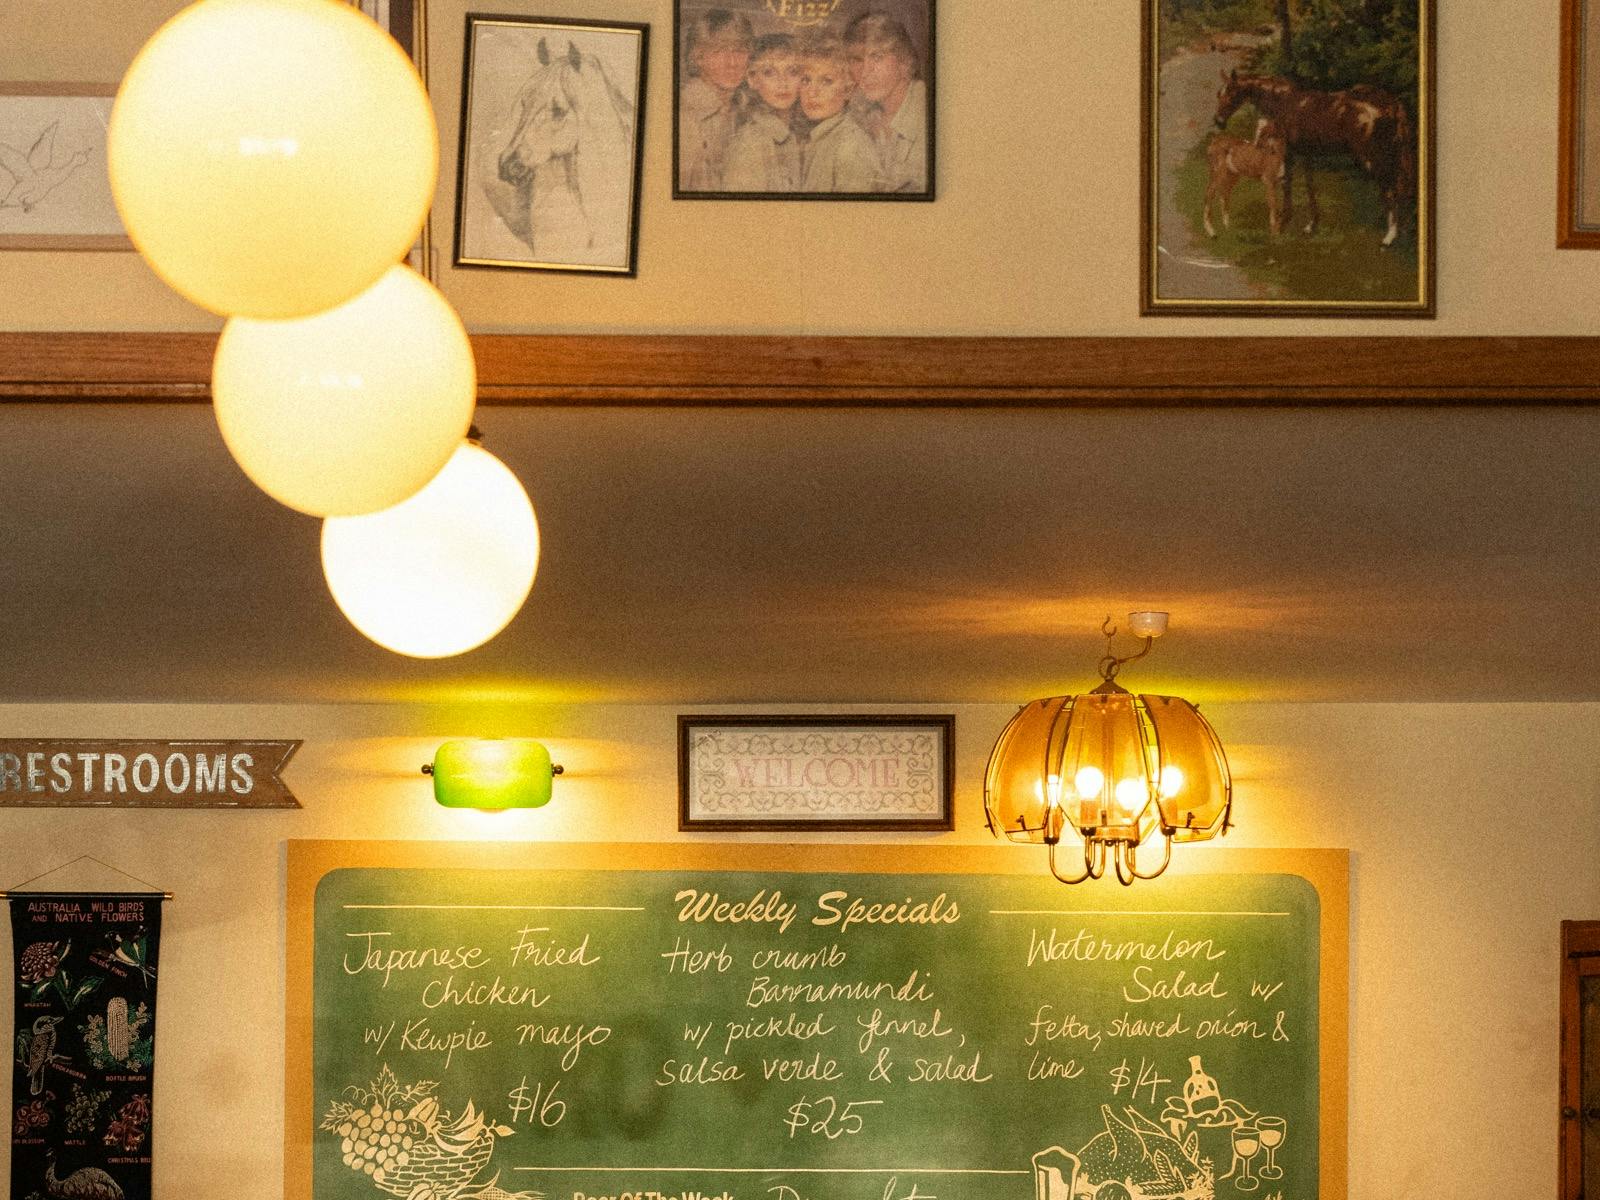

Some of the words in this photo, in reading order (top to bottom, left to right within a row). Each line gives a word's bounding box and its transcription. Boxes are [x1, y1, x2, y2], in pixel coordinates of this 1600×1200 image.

[0, 752, 254, 794] RESTROOMS
[732, 757, 899, 788] WELCOME
[28, 902, 80, 913] AUSTRALIA
[91, 901, 114, 912] WILD
[119, 901, 144, 912] BIRDS
[32, 914, 48, 922] AND
[55, 914, 93, 922] NATIVE
[101, 912, 145, 922] FLOWERS
[675, 890, 798, 934] Weekly
[811, 891, 960, 933] Specials
[343, 931, 490, 989] Japanese
[511, 924, 600, 968] Fried
[662, 936, 733, 975] Herb
[1027, 928, 1226, 967] Watermelon
[422, 976, 550, 1009] Chicken
[747, 971, 934, 1008] Barramundi
[1124, 966, 1227, 1003] Salad
[1251, 980, 1283, 1001] w/
[684, 1022, 712, 1049] w/
[725, 1013, 837, 1054] pickled
[1106, 1013, 1190, 1039] shaved
[1197, 1009, 1267, 1040] onion
[1274, 1012, 1290, 1041] &
[365, 1022, 395, 1054] w/
[400, 1019, 494, 1069] Kewpie
[516, 1023, 611, 1071] mayo
[762, 1052, 844, 1081] verde
[868, 1047, 892, 1083] &
[908, 1051, 993, 1082] salad
[1110, 1057, 1171, 1104] $14
[508, 1075, 567, 1127] $16
[783, 1095, 884, 1139] $25
